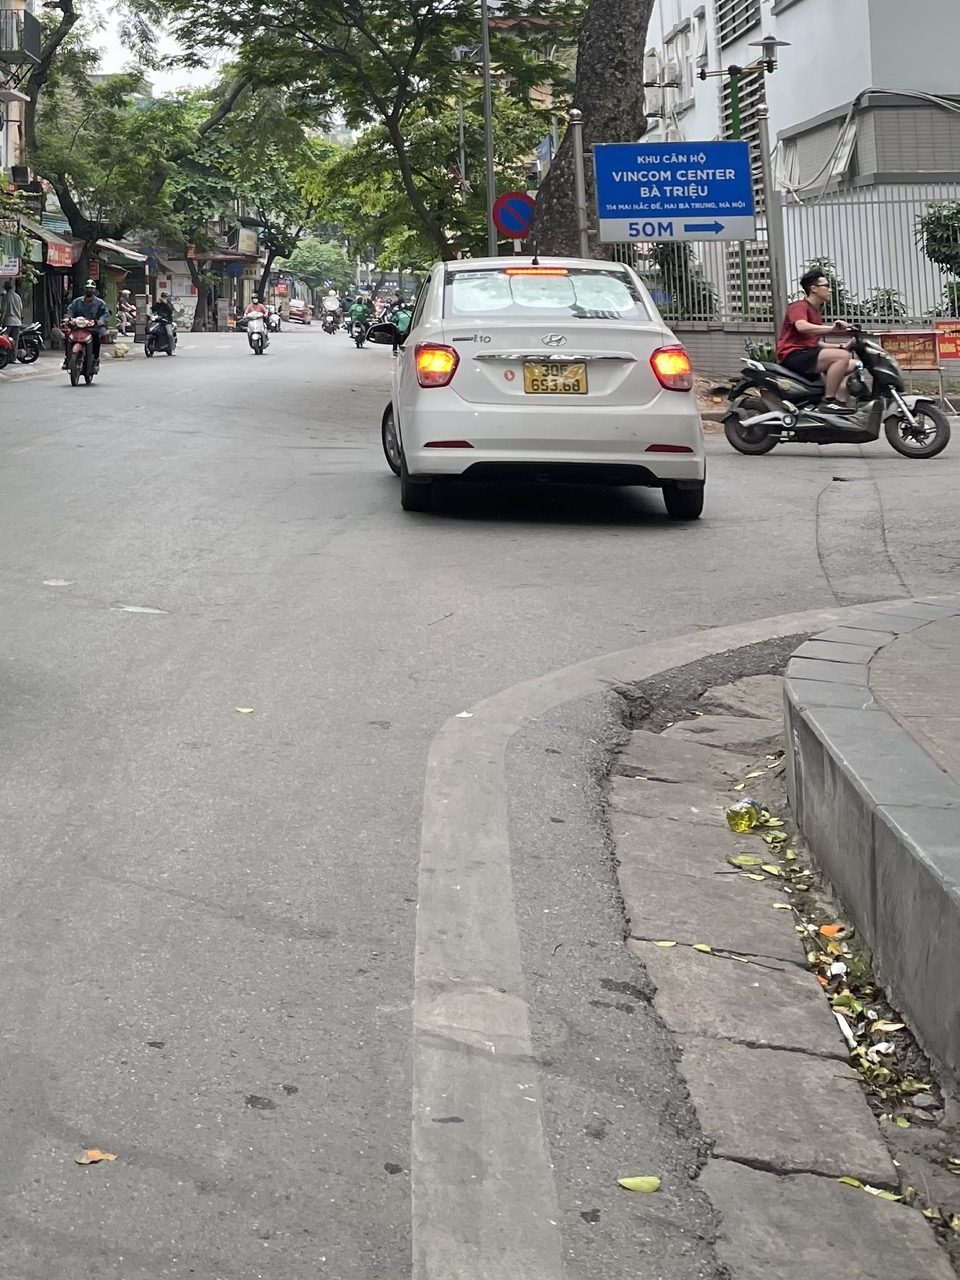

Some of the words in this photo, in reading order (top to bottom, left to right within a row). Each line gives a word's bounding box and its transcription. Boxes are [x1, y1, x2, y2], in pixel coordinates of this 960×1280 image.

[637, 155, 660, 164] KHU
[662, 152, 687, 163] CĂN
[690, 152, 707, 165] HỘ
[612, 171, 672, 182] VINCOM
[676, 169, 736, 181] CENTER
[640, 184, 661, 198] BÀ
[664, 182, 709, 199] TRIỆU
[633, 201, 650, 210] HẮC
[678, 201, 690, 209] BÀ
[719, 200, 731, 209] HÀ
[732, 199, 746, 210] NỘI
[628, 221, 674, 238] 50M
[473, 334, 492, 344] i10
